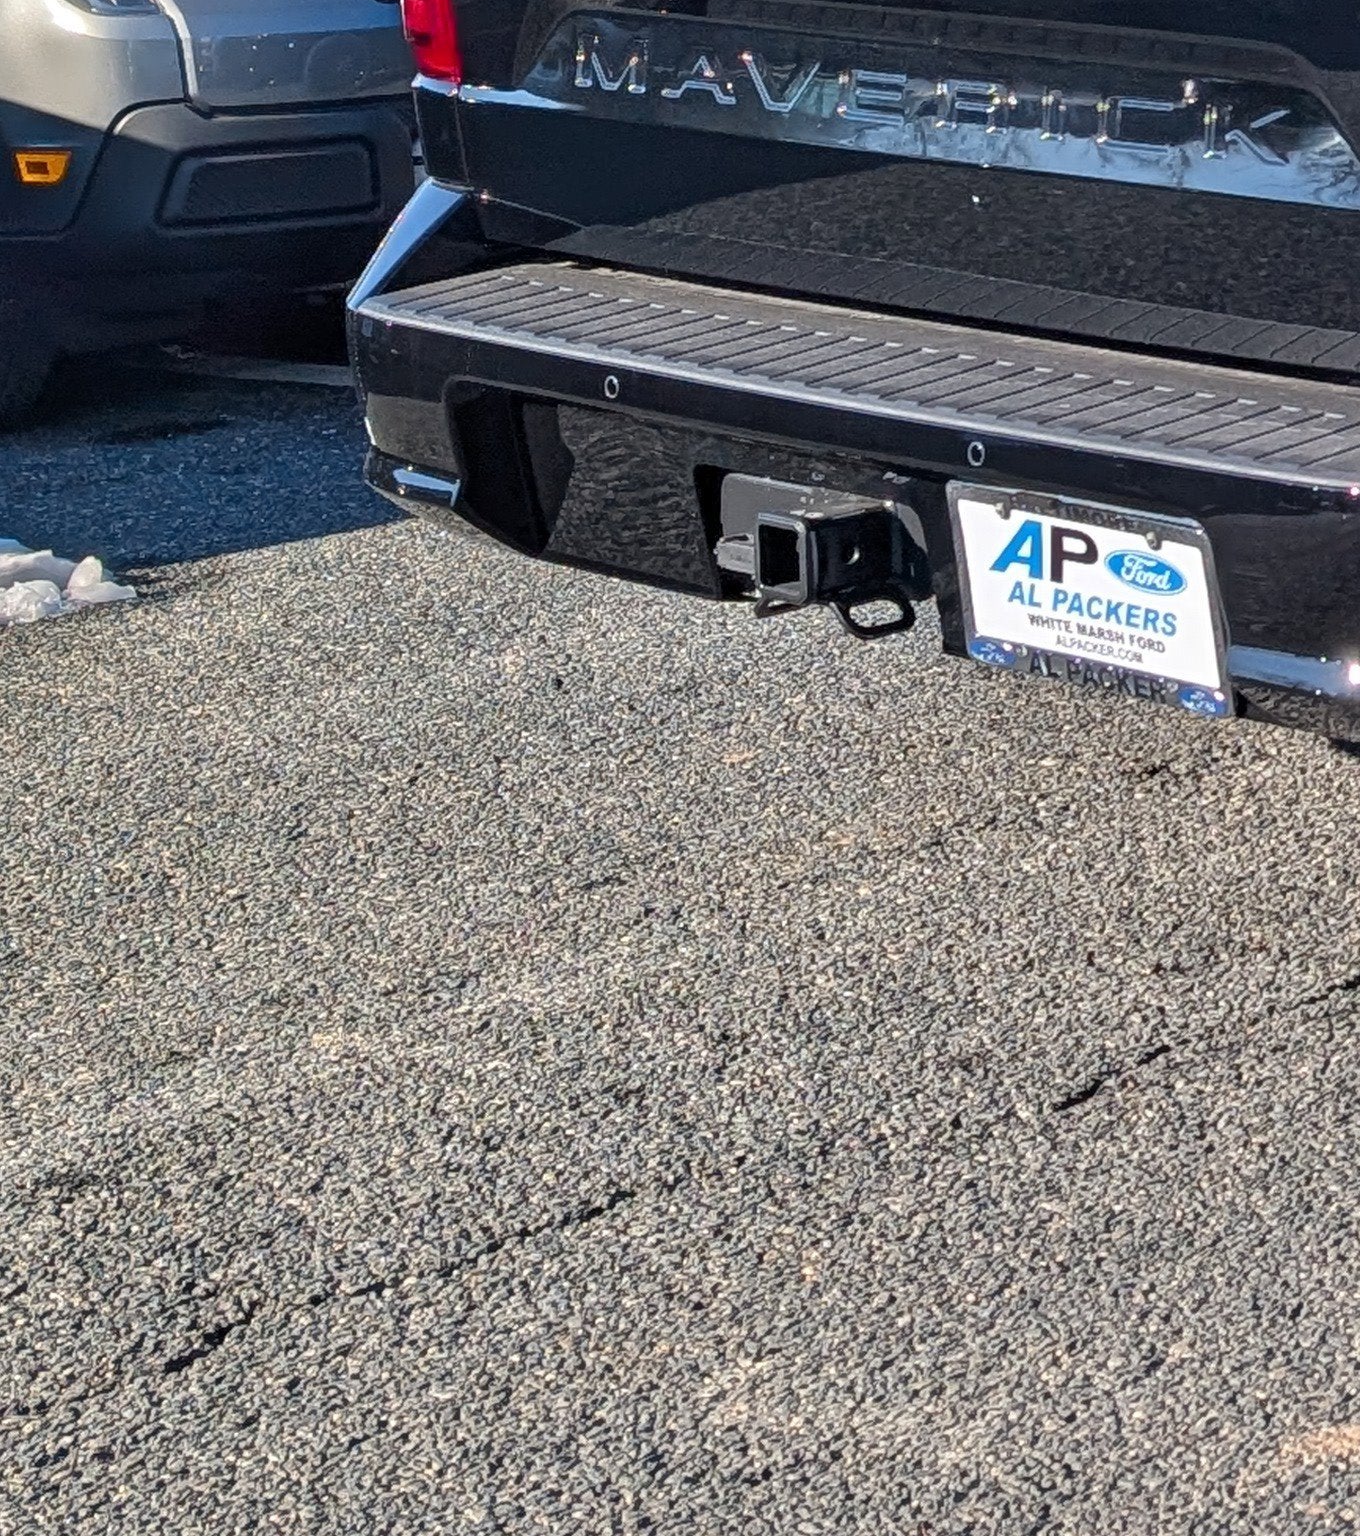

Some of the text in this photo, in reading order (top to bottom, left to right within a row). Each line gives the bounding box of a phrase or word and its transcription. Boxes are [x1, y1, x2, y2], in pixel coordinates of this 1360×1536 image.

[574, 31, 1292, 166] MAVERICK
[989, 519, 1099, 584] AP
[1120, 553, 1172, 591] Ford
[1008, 580, 1178, 637] AL PACKERS
[1027, 613, 1166, 653] WHITE MARSH FORD
